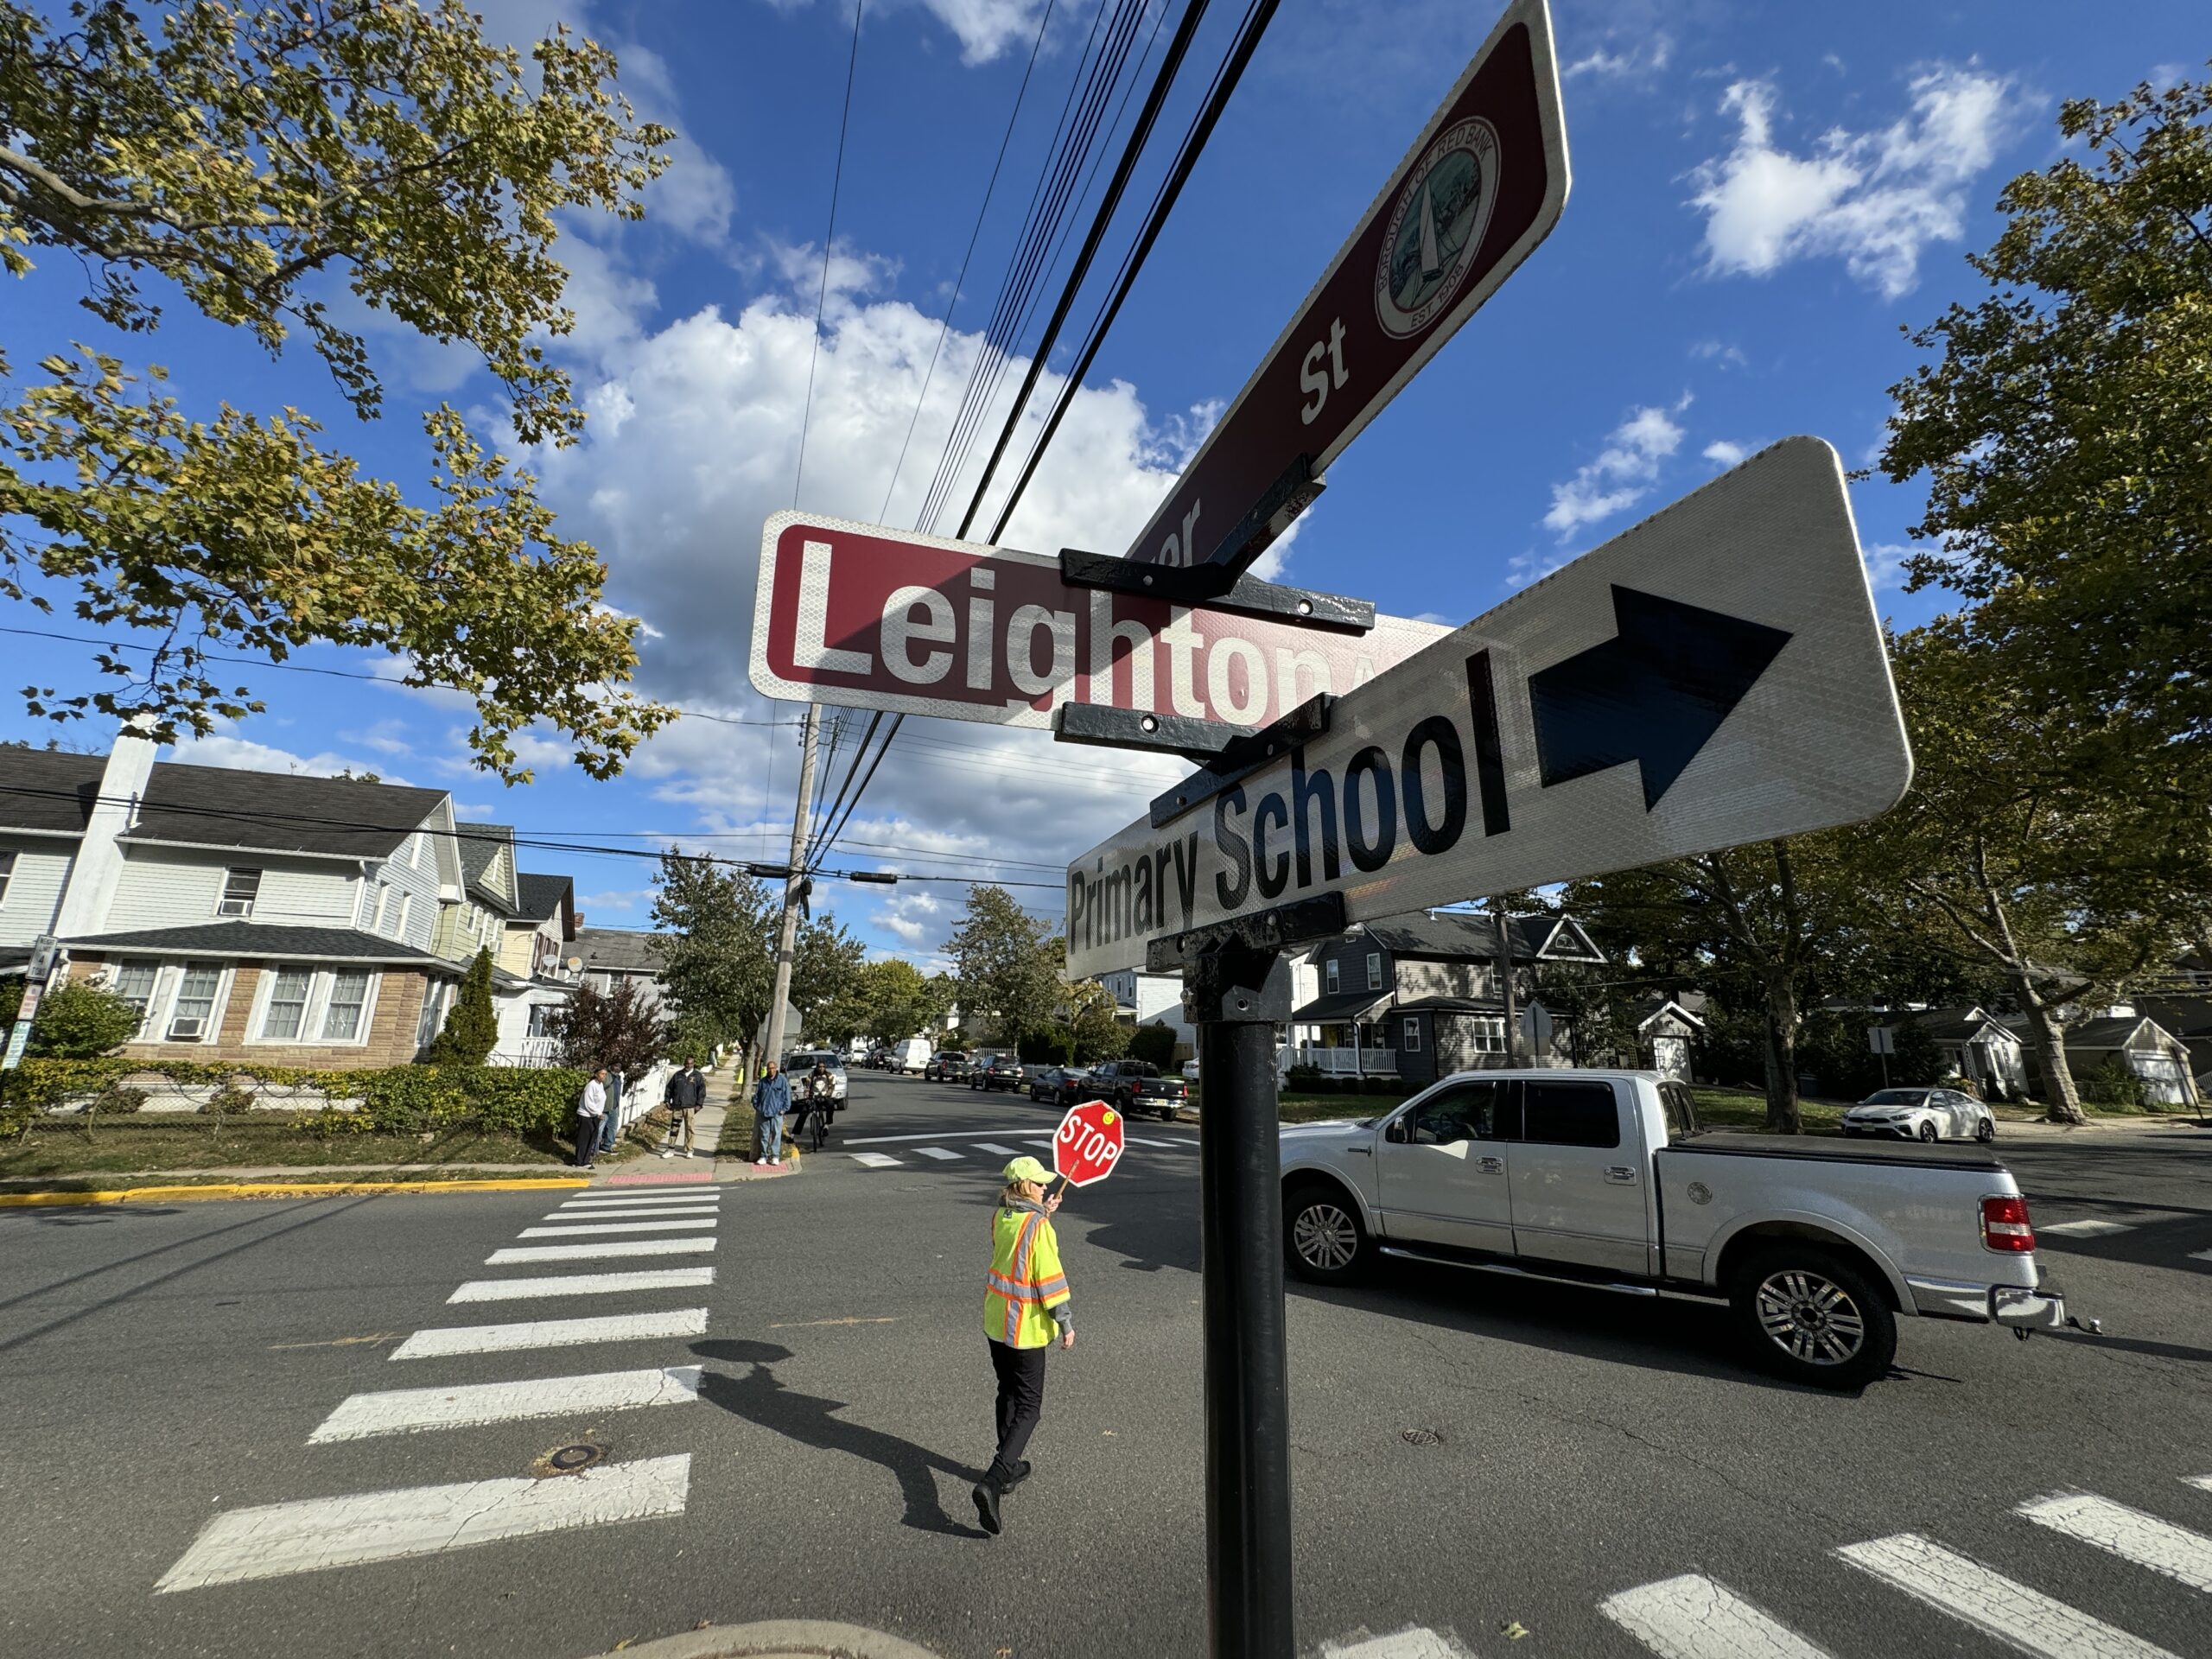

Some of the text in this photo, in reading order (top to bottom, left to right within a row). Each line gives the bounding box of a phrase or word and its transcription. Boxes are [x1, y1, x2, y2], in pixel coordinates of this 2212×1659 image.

[1378, 124, 1492, 292] BOROUGH OF RED BANK
[1438, 263, 1464, 302] 1908
[1149, 315, 1350, 568] er St
[792, 540, 1333, 730] Leighton
[1070, 648, 1510, 955] Primary School
[1059, 1115, 1118, 1168] STOP
